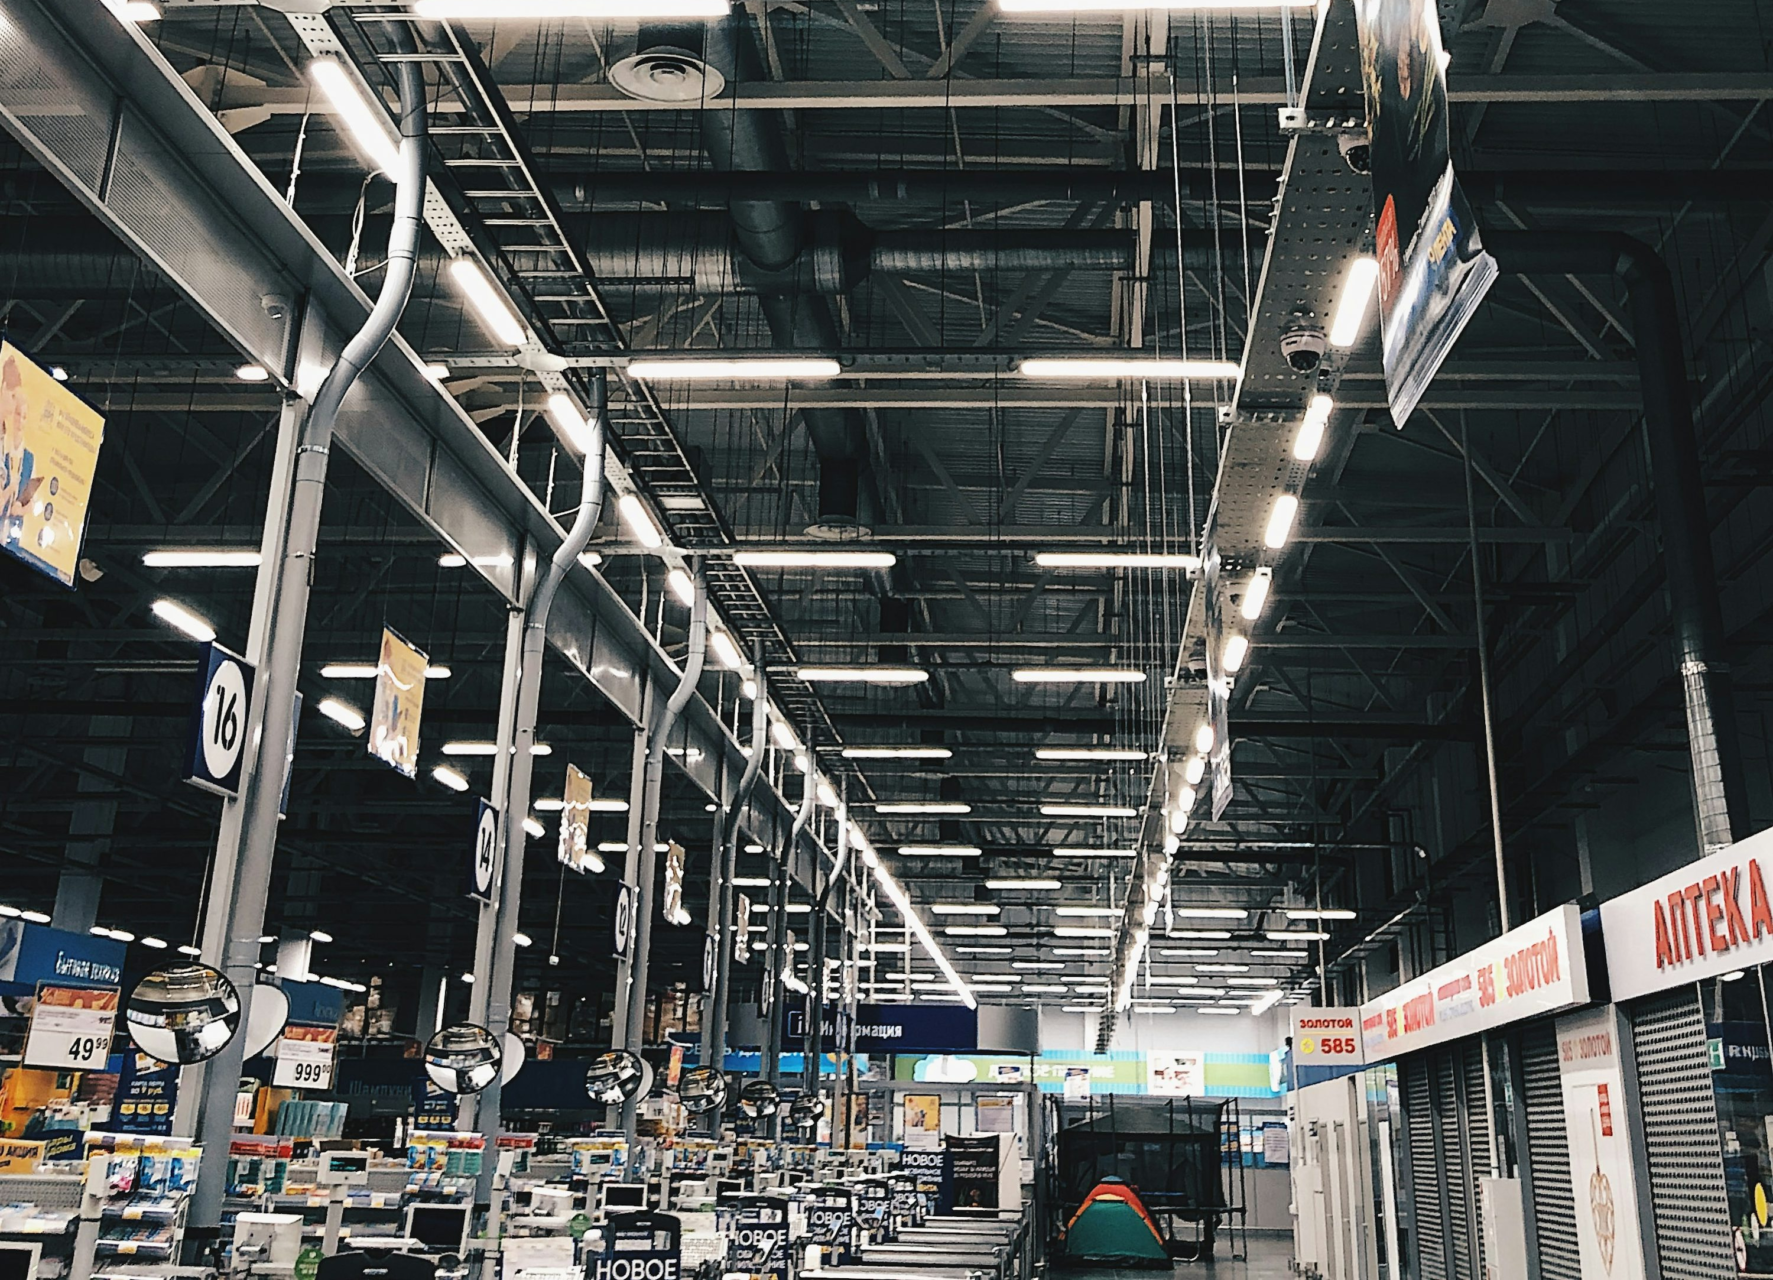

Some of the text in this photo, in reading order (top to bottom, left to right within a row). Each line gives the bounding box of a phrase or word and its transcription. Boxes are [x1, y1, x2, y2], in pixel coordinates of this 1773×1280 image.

[213, 684, 238, 752] 16
[479, 826, 492, 873] 14
[1654, 858, 1773, 969] АПТЕКА
[1504, 925, 1561, 999] ЗОЛОТОЙ
[1299, 1017, 1353, 1029] ЗОЛОТОЙ
[68, 1036, 109, 1061] 49 99
[1321, 1037, 1356, 1054] 585
[295, 1063, 321, 1083] 999
[350, 1081, 412, 1097] Шампуни
[902, 1153, 944, 1167] НОВОЕ
[596, 1258, 678, 1280] НОВОЕ
